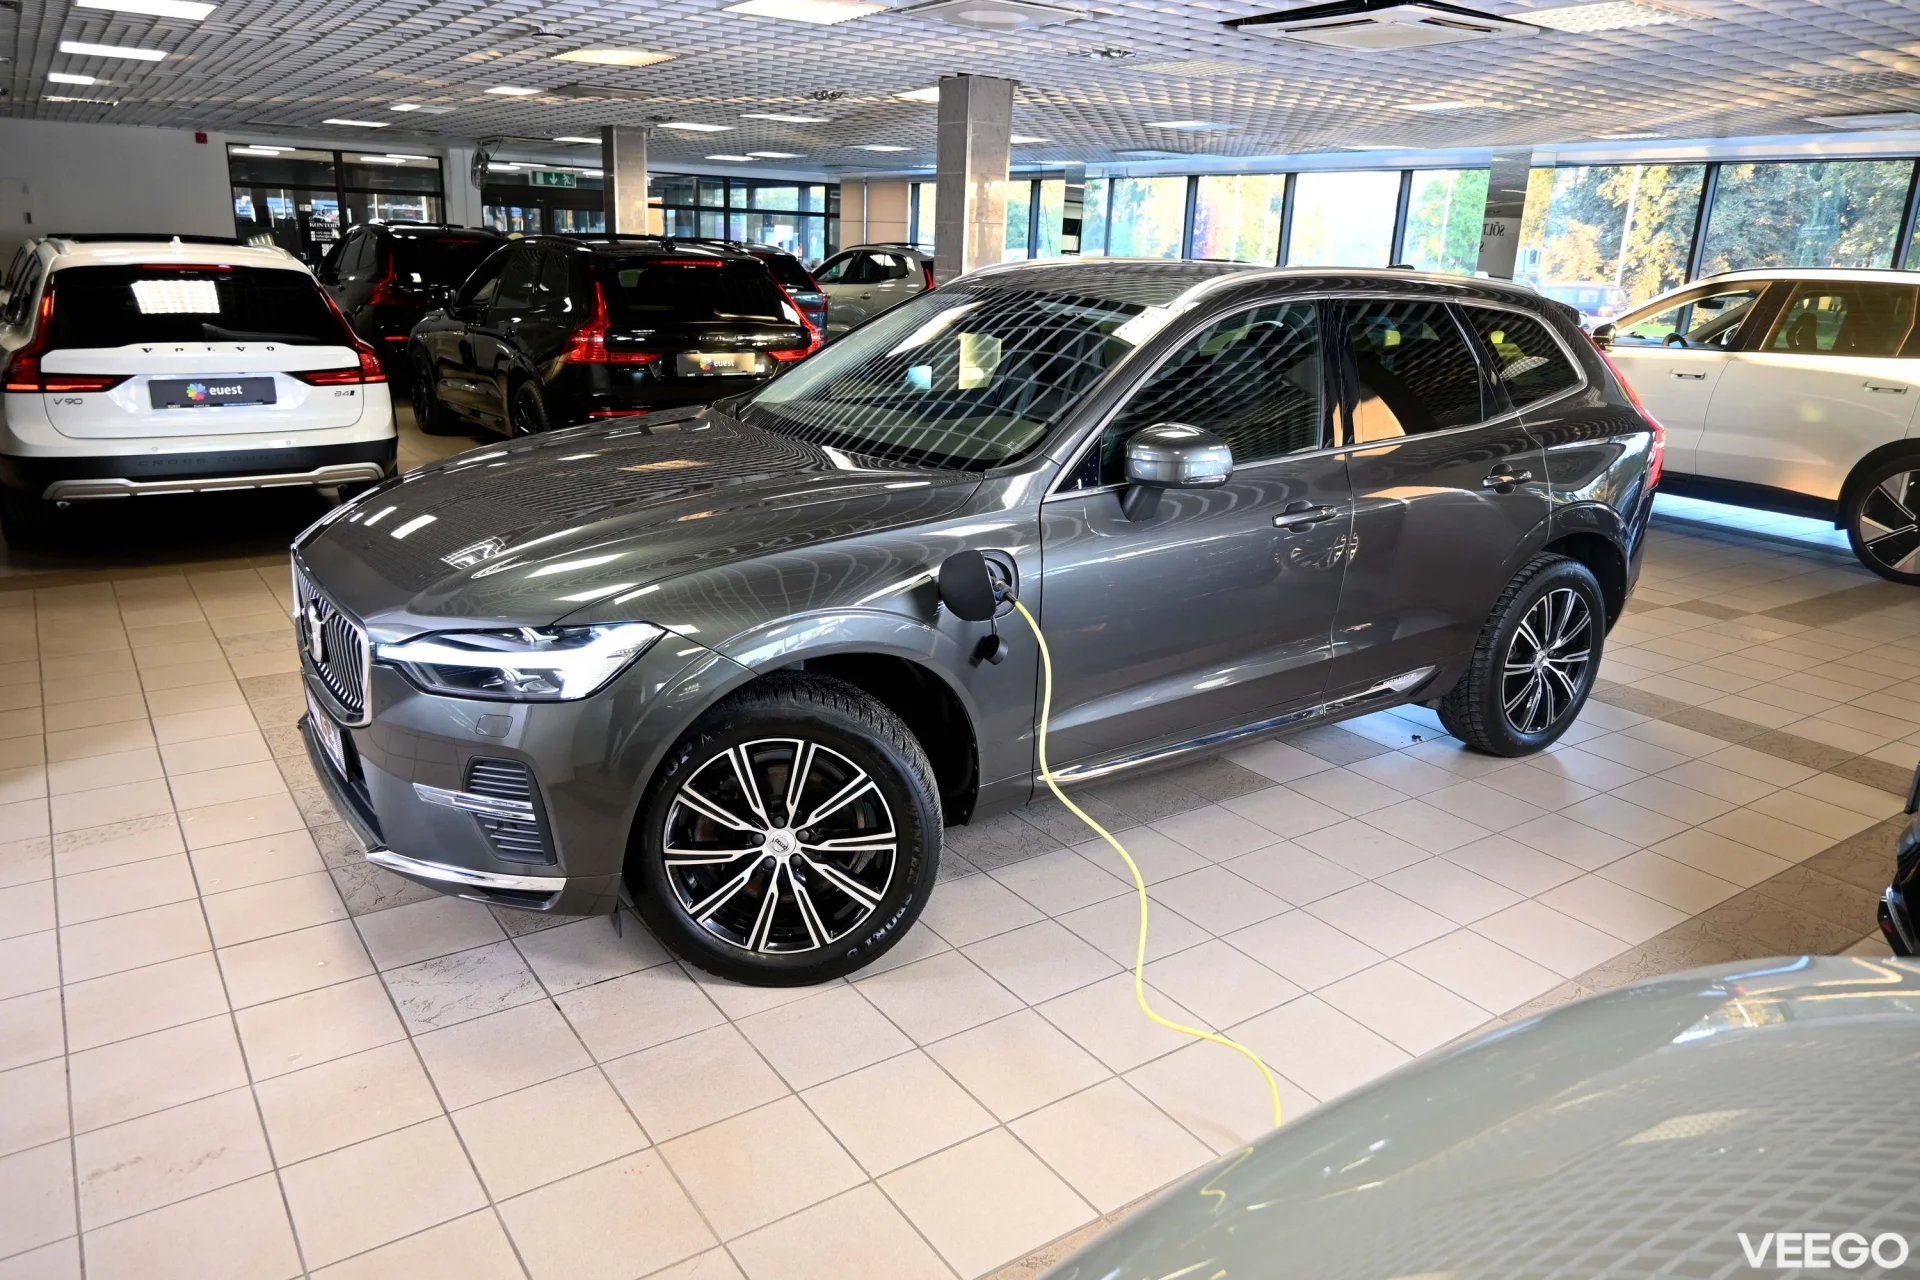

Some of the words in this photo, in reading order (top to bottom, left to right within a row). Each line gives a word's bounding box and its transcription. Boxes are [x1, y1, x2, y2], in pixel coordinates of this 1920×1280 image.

[141, 345, 275, 353] VOLVO
[713, 360, 735, 368] euest
[209, 385, 243, 396] euest
